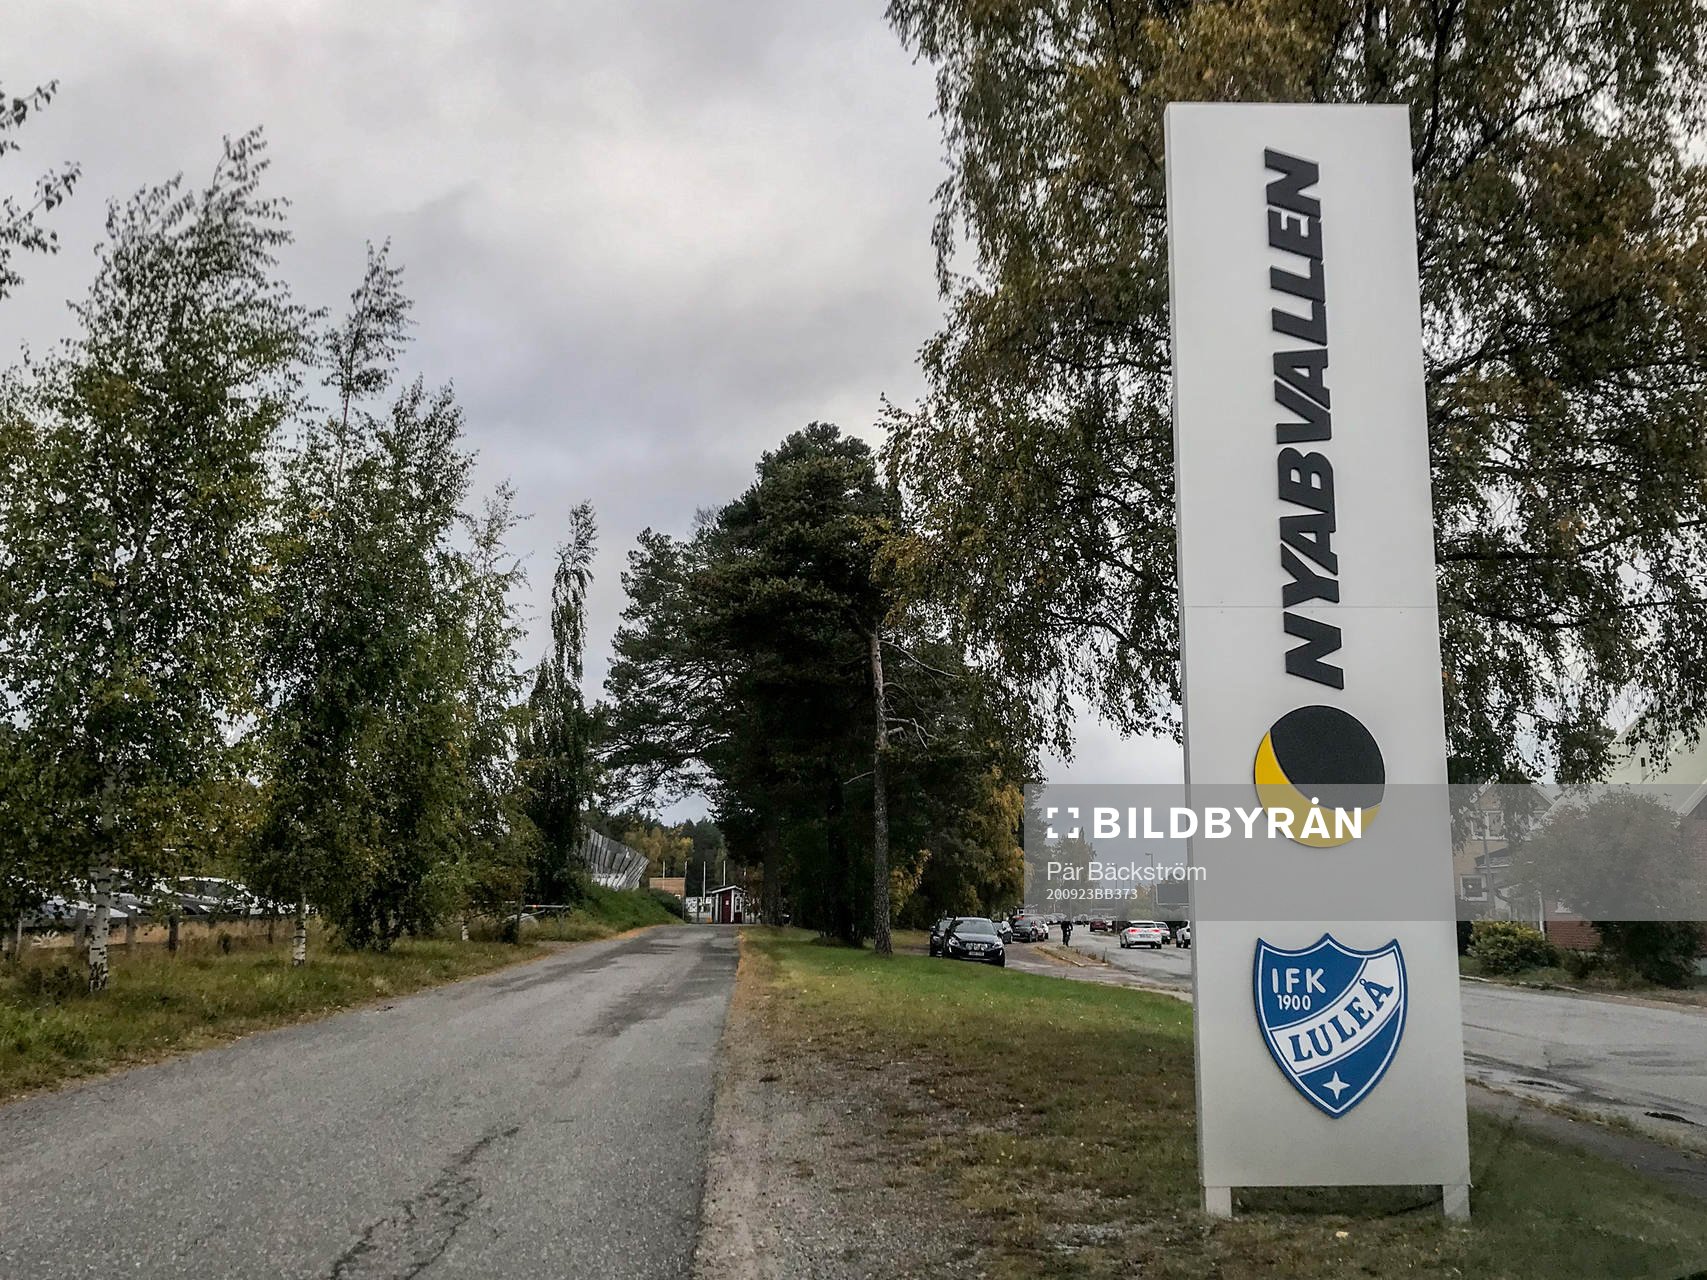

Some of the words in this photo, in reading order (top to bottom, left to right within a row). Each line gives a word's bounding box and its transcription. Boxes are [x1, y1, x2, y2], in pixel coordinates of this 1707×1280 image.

[1264, 146, 1344, 690] NYABVALLEN
[1271, 967, 1327, 994] IFK
[1277, 995, 1312, 1011] 1900
[1288, 978, 1395, 1062] LULEÅ
